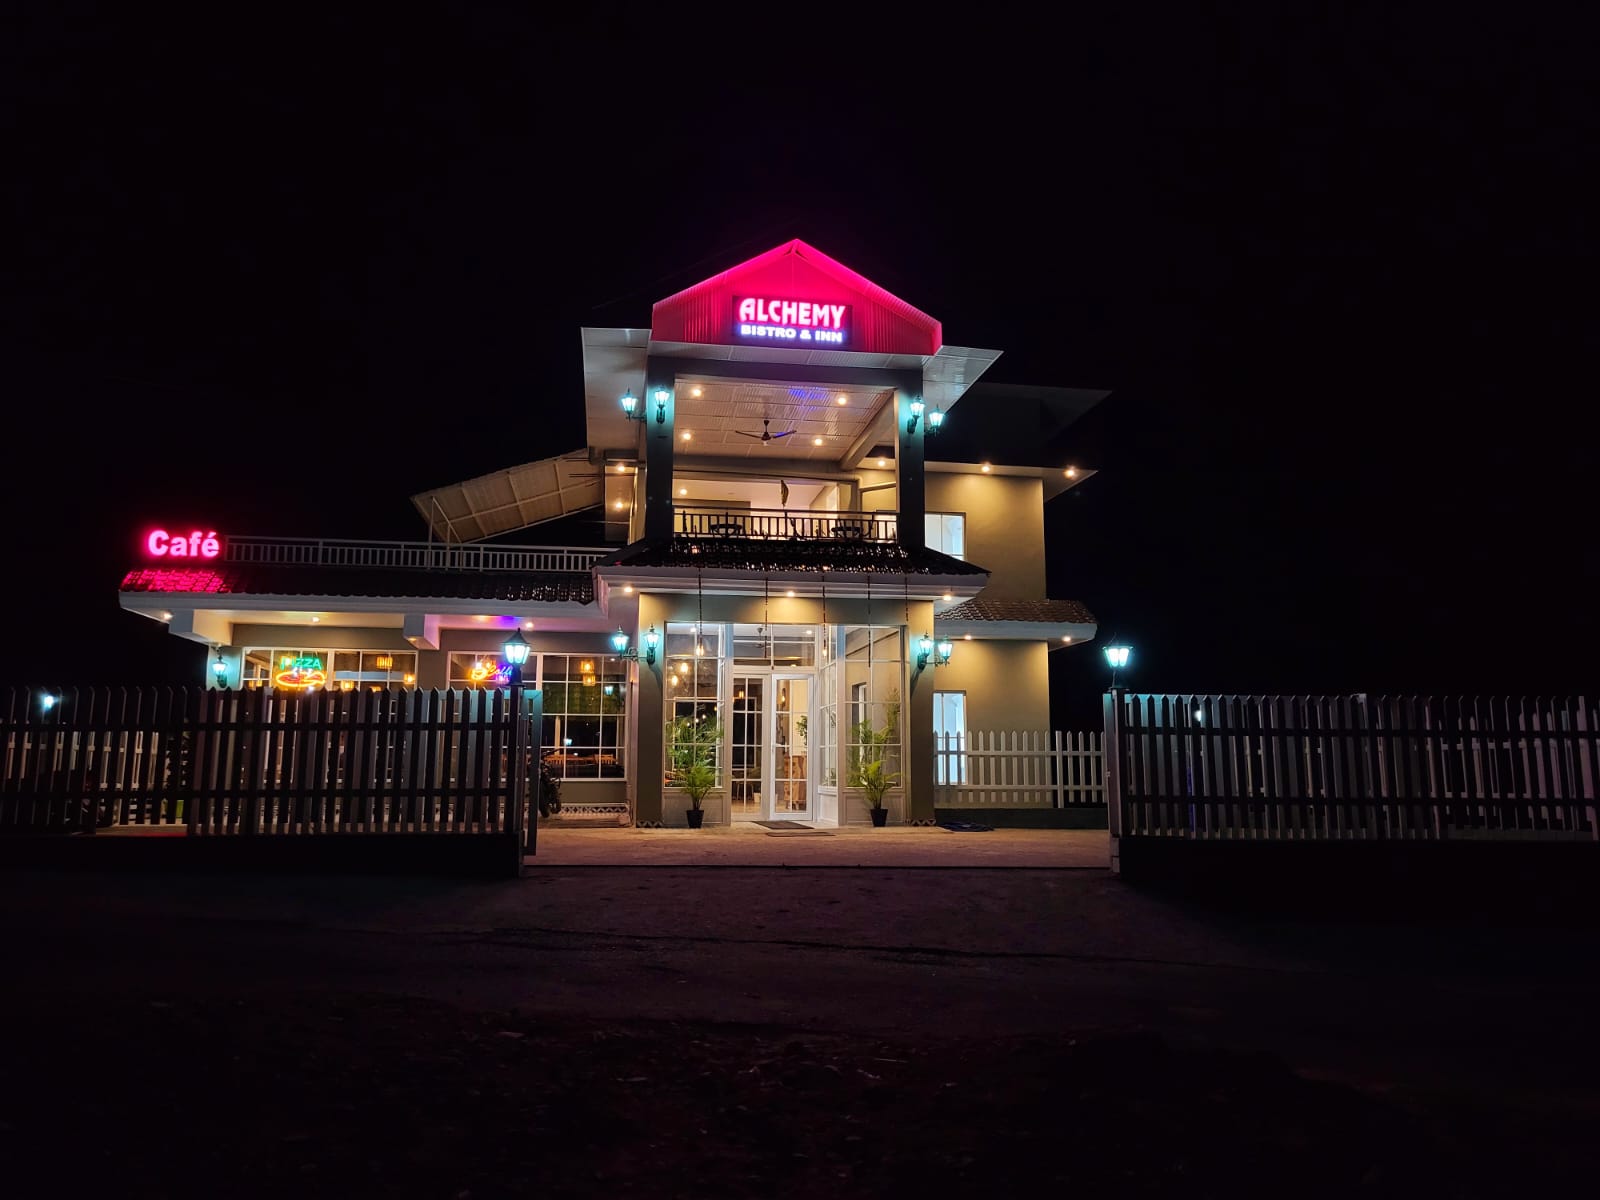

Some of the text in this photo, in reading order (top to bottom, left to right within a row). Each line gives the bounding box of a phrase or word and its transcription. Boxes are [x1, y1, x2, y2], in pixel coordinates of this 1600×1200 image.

[739, 298, 846, 329] ALCHEMY
[740, 324, 843, 342] BISTRO & INN
[148, 530, 219, 558] Café
